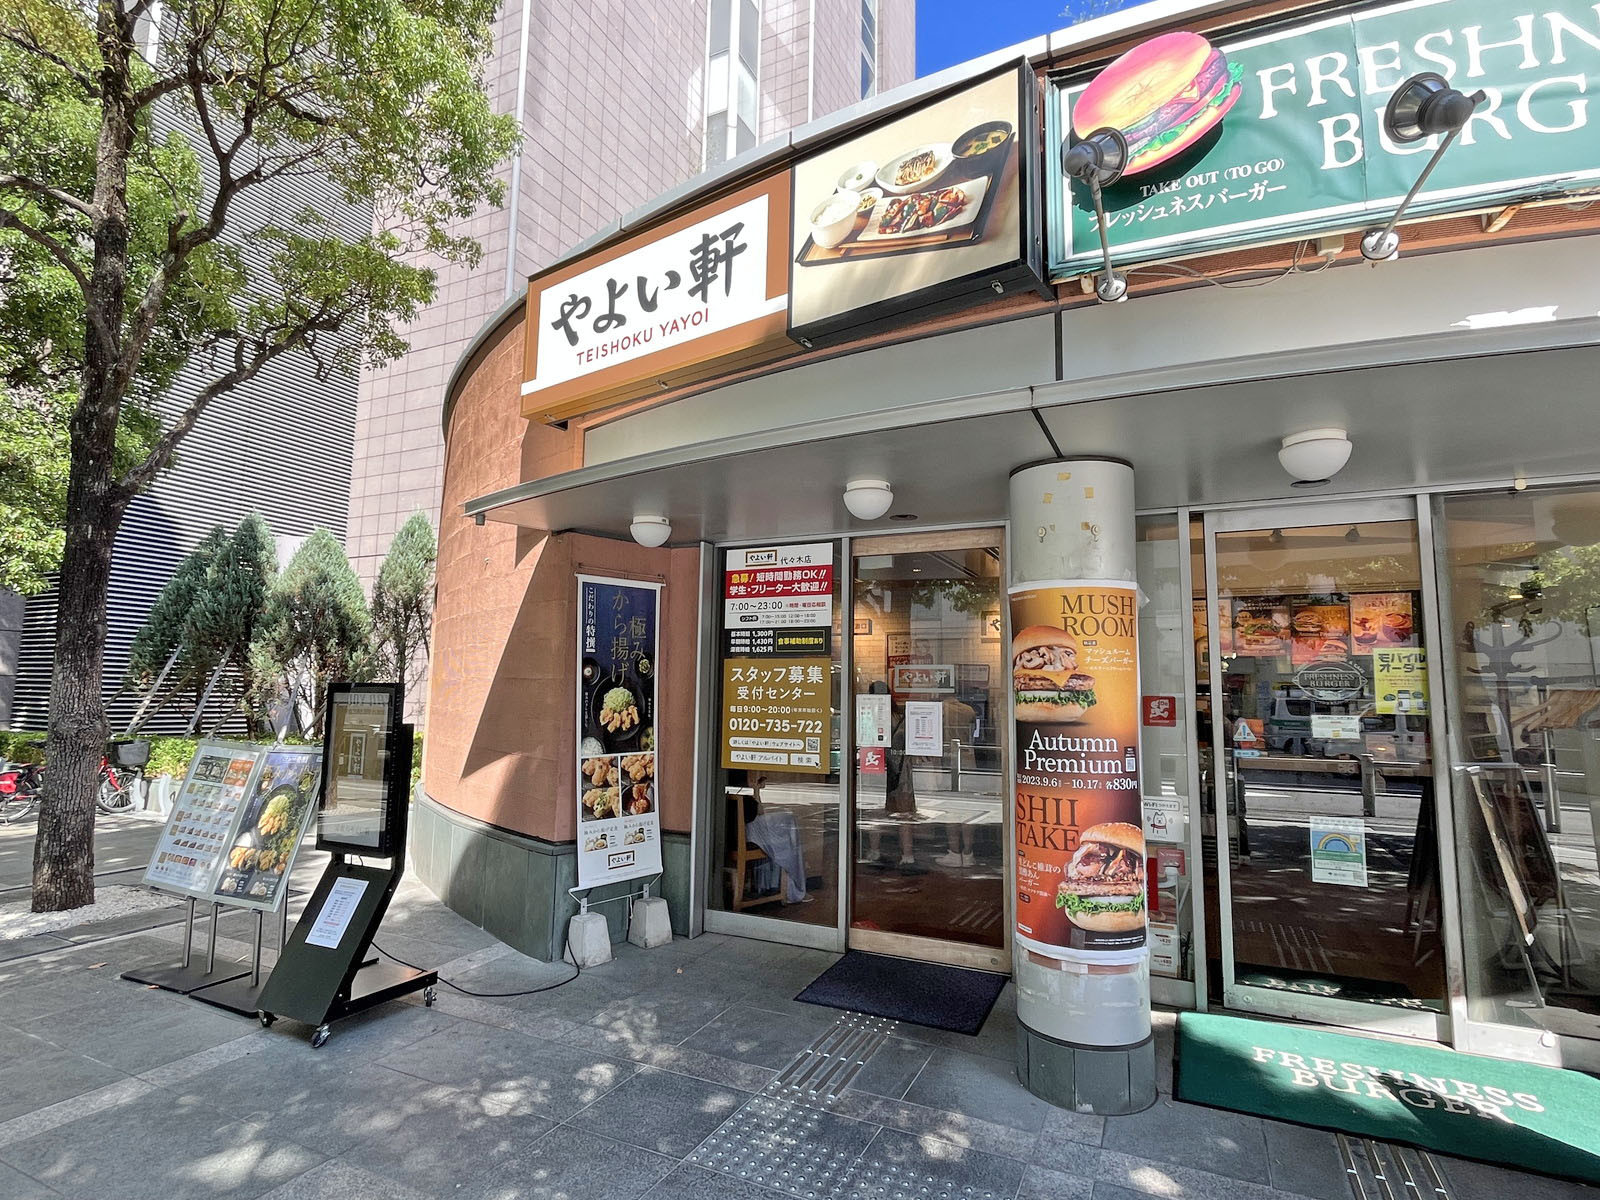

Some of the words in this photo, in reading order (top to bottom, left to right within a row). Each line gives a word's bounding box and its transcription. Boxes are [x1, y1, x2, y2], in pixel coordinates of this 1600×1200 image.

[1139, 179, 1181, 198] TAKE
[1186, 171, 1219, 188] OUT
[1223, 164, 1251, 181] (TO
[1254, 157, 1285, 174] GO)
[550, 222, 748, 347] やよい軒
[577, 327, 653, 365] TEISHOKU
[659, 307, 710, 338] YAYOI
[781, 555, 812, 565] 代々木店
[1061, 594, 1134, 616] MUSH
[629, 616, 647, 660] 極み
[1061, 616, 1135, 638] ROOM
[611, 590, 630, 687] から揚げ
[1378, 653, 1426, 663] モバイル
[1379, 663, 1426, 673] オーダー
[731, 665, 824, 684] スタッフ募集
[904, 671, 947, 684] やよい軒
[1303, 673, 1355, 681] FRESHNESS
[1309, 680, 1352, 688] BURGER
[737, 686, 816, 700] 受付センター
[729, 717, 823, 734] 0120-735-722
[1029, 728, 1119, 753] Autumn
[1024, 749, 1124, 774] Premium
[1022, 774, 1058, 787] 2023.9.6
[1071, 779, 1099, 790] 10.17
[1017, 792, 1080, 828] SHII
[1017, 820, 1081, 852] TAKE
[1250, 1046, 1547, 1113] FRESHNESS
[1291, 1068, 1516, 1125] BURGER
